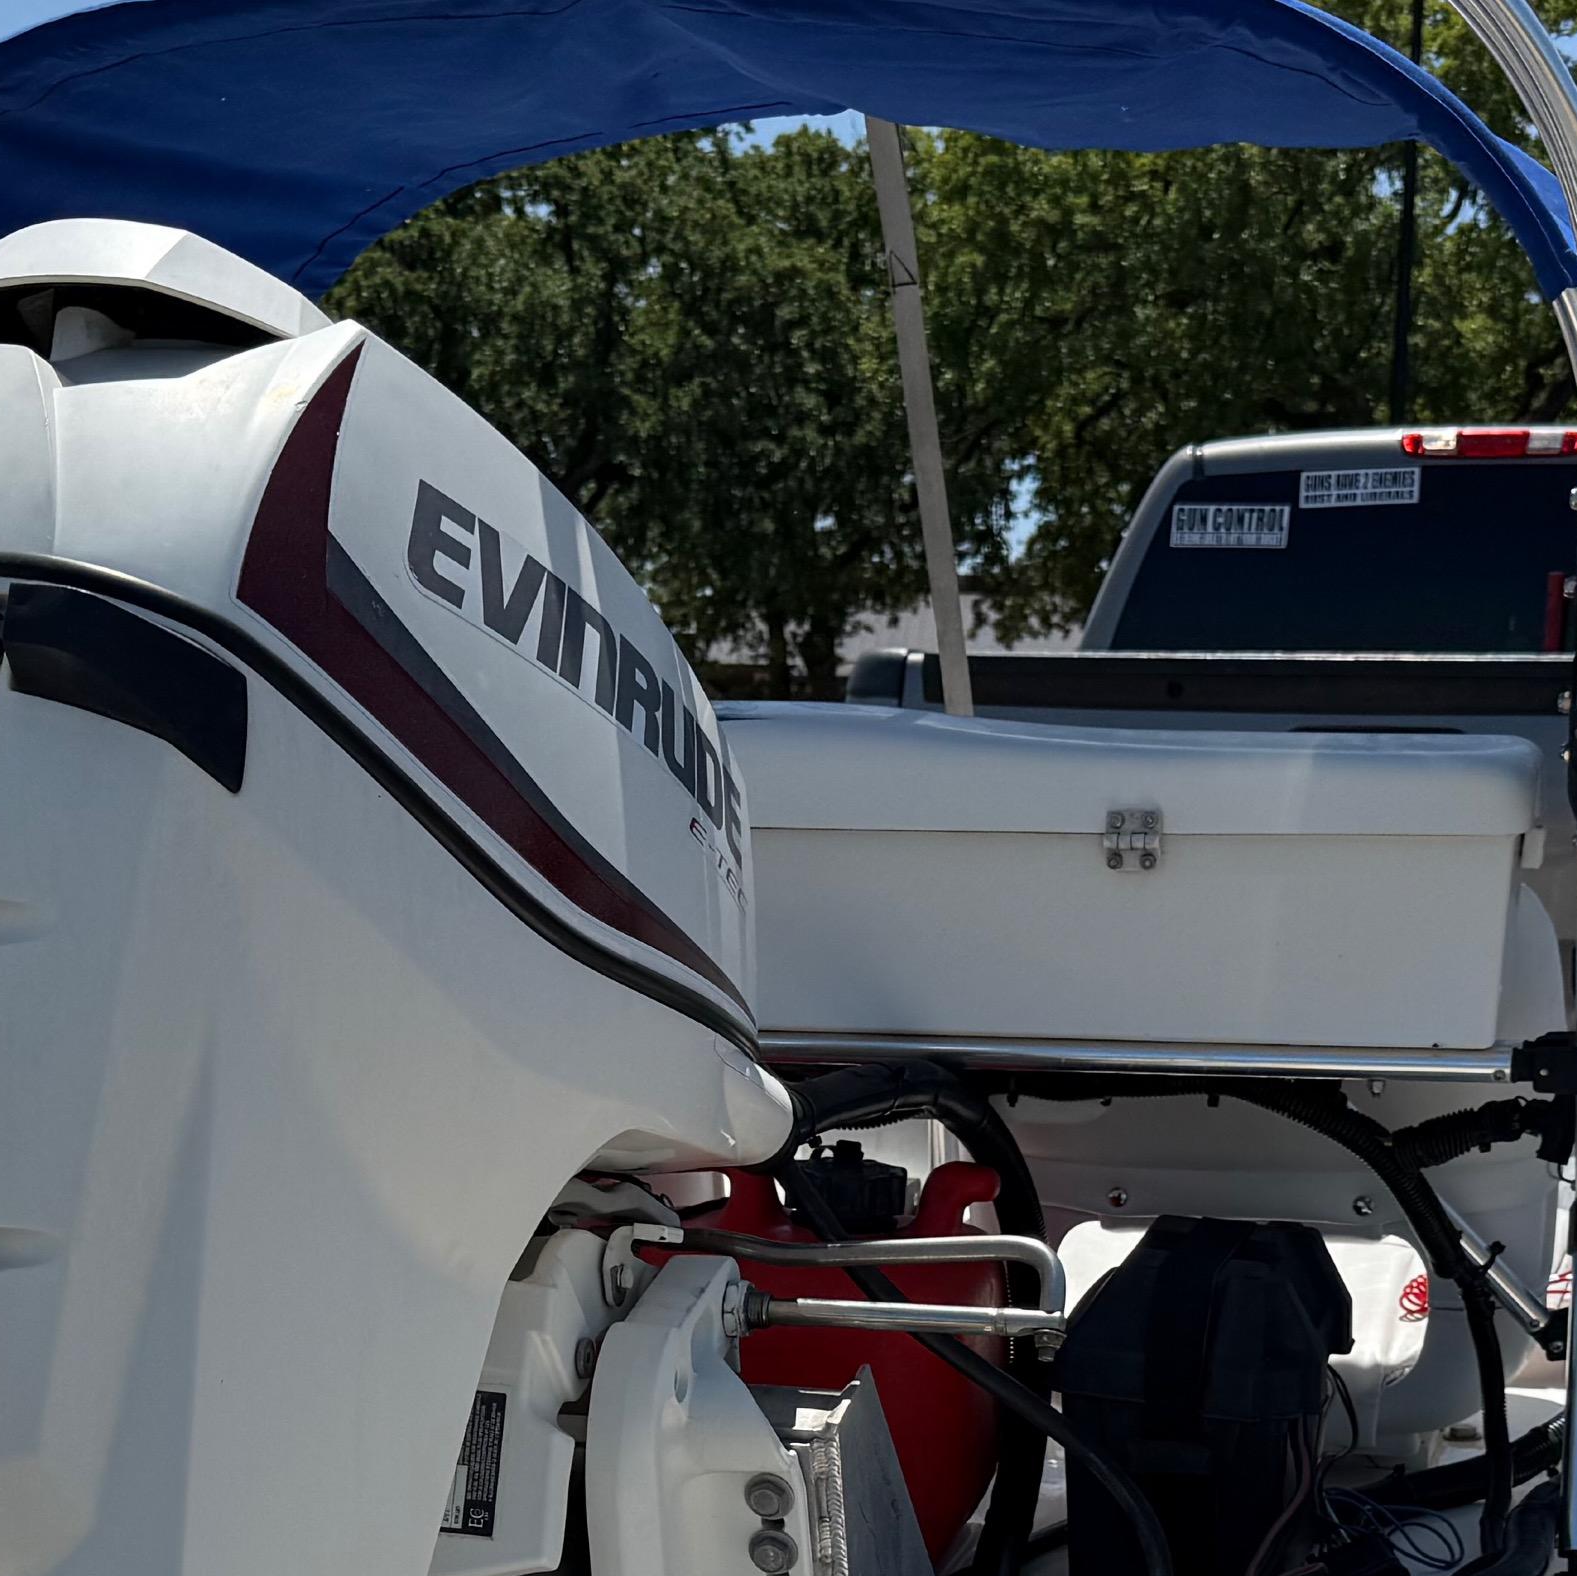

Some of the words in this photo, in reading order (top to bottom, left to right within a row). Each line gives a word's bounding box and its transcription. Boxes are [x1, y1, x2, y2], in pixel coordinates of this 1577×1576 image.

[1304, 474, 1332, 492] GUNS
[1336, 472, 1361, 491] HAVE
[1362, 472, 1369, 490] 2
[1371, 470, 1415, 489] ENEMIES
[1335, 492, 1357, 503] AND
[1360, 490, 1414, 502] LIBERALS
[1176, 507, 1208, 531] GUN
[1212, 507, 1284, 531] CONTROL
[406, 478, 743, 872] EVINRUDE
